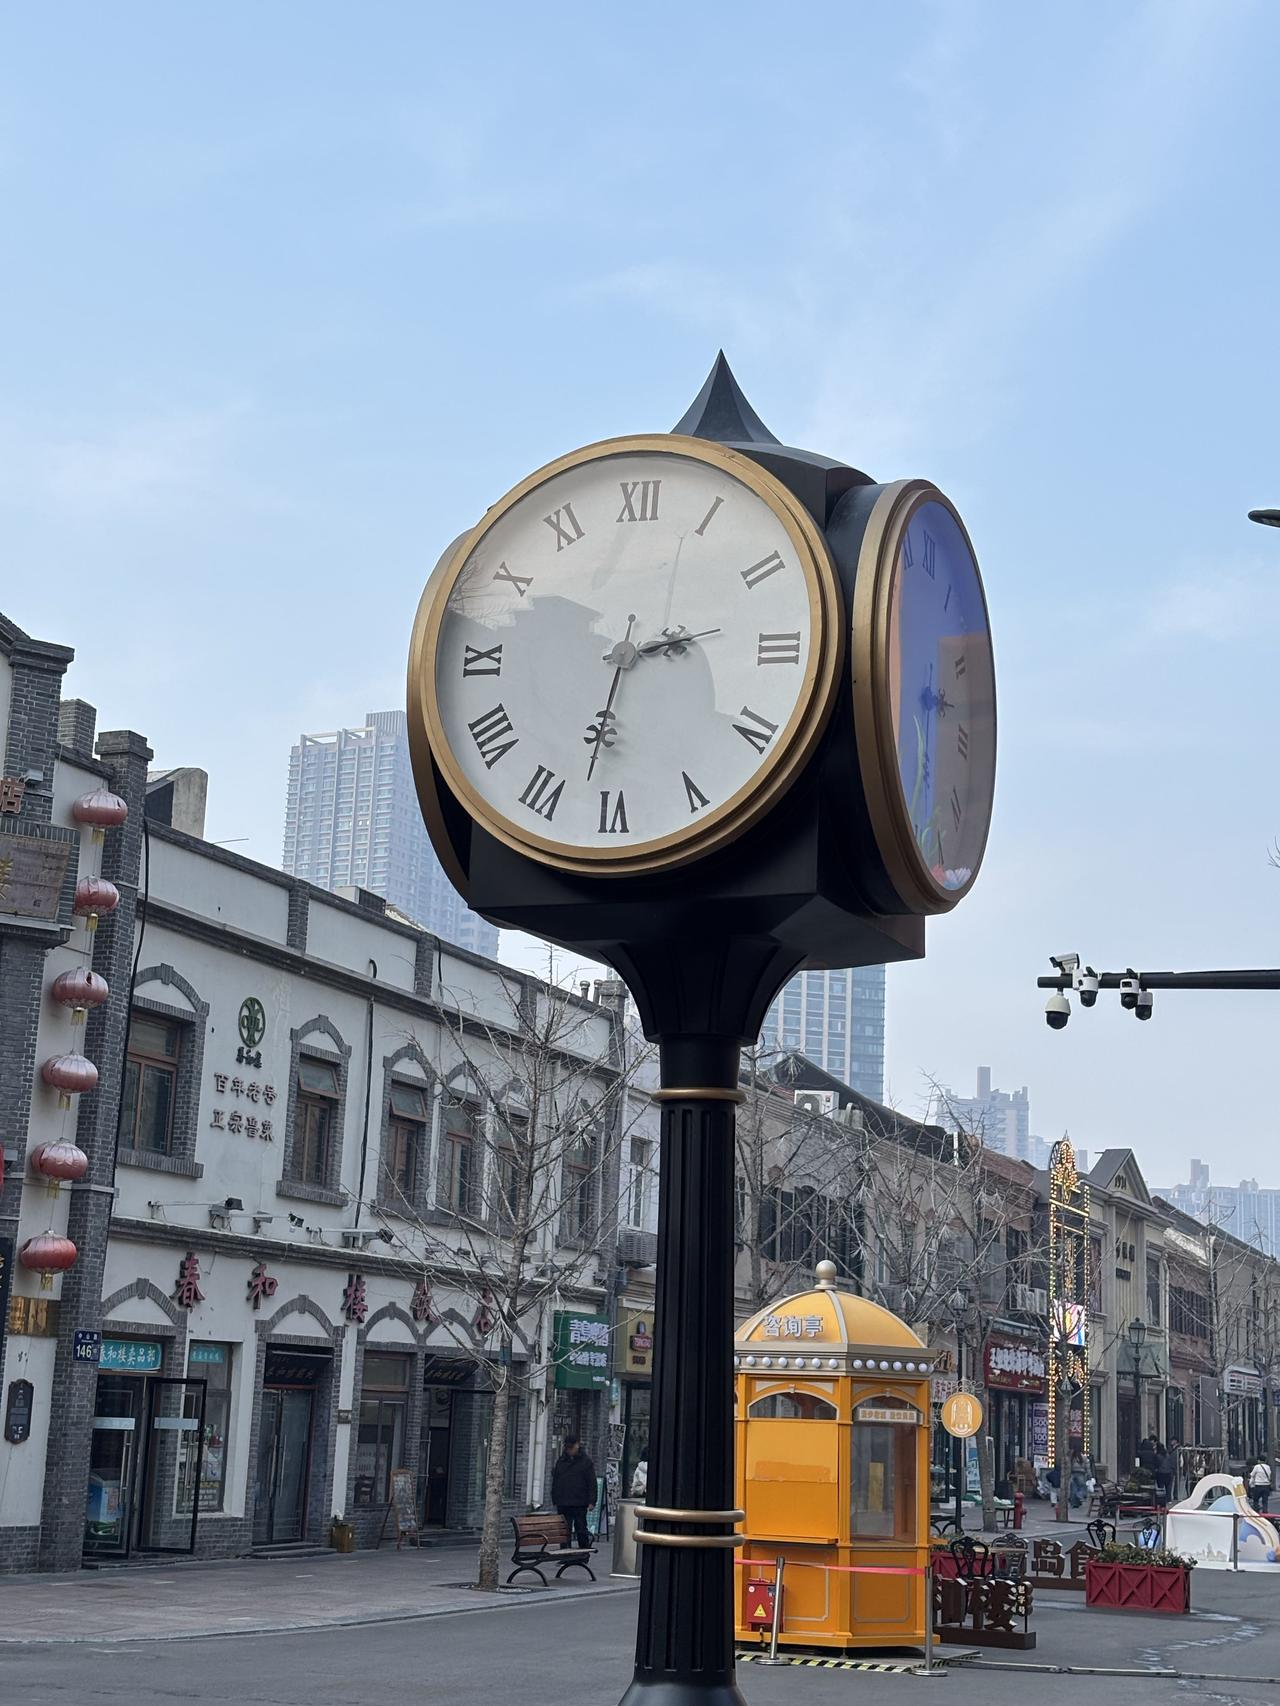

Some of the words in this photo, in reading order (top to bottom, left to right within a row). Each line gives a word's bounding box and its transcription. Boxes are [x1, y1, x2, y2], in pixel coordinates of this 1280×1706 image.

[616, 480, 662, 522] XII
[694, 496, 724, 536] I
[543, 502, 586, 552] XI
[493, 561, 534, 597] X
[740, 550, 786, 590] II
[463, 643, 503, 678] IX
[757, 631, 801, 666] III
[468, 703, 520, 770] VIII
[732, 706, 780, 755] IV
[518, 764, 567, 822] VII
[598, 790, 630, 833] VI
[681, 771, 711, 813] V
[214, 1072, 278, 1106] 百年老号
[210, 1108, 274, 1142] 正宗鲁菜
[763, 1314, 825, 1338] 咨询亭
[76, 1344, 92, 1358] 146
